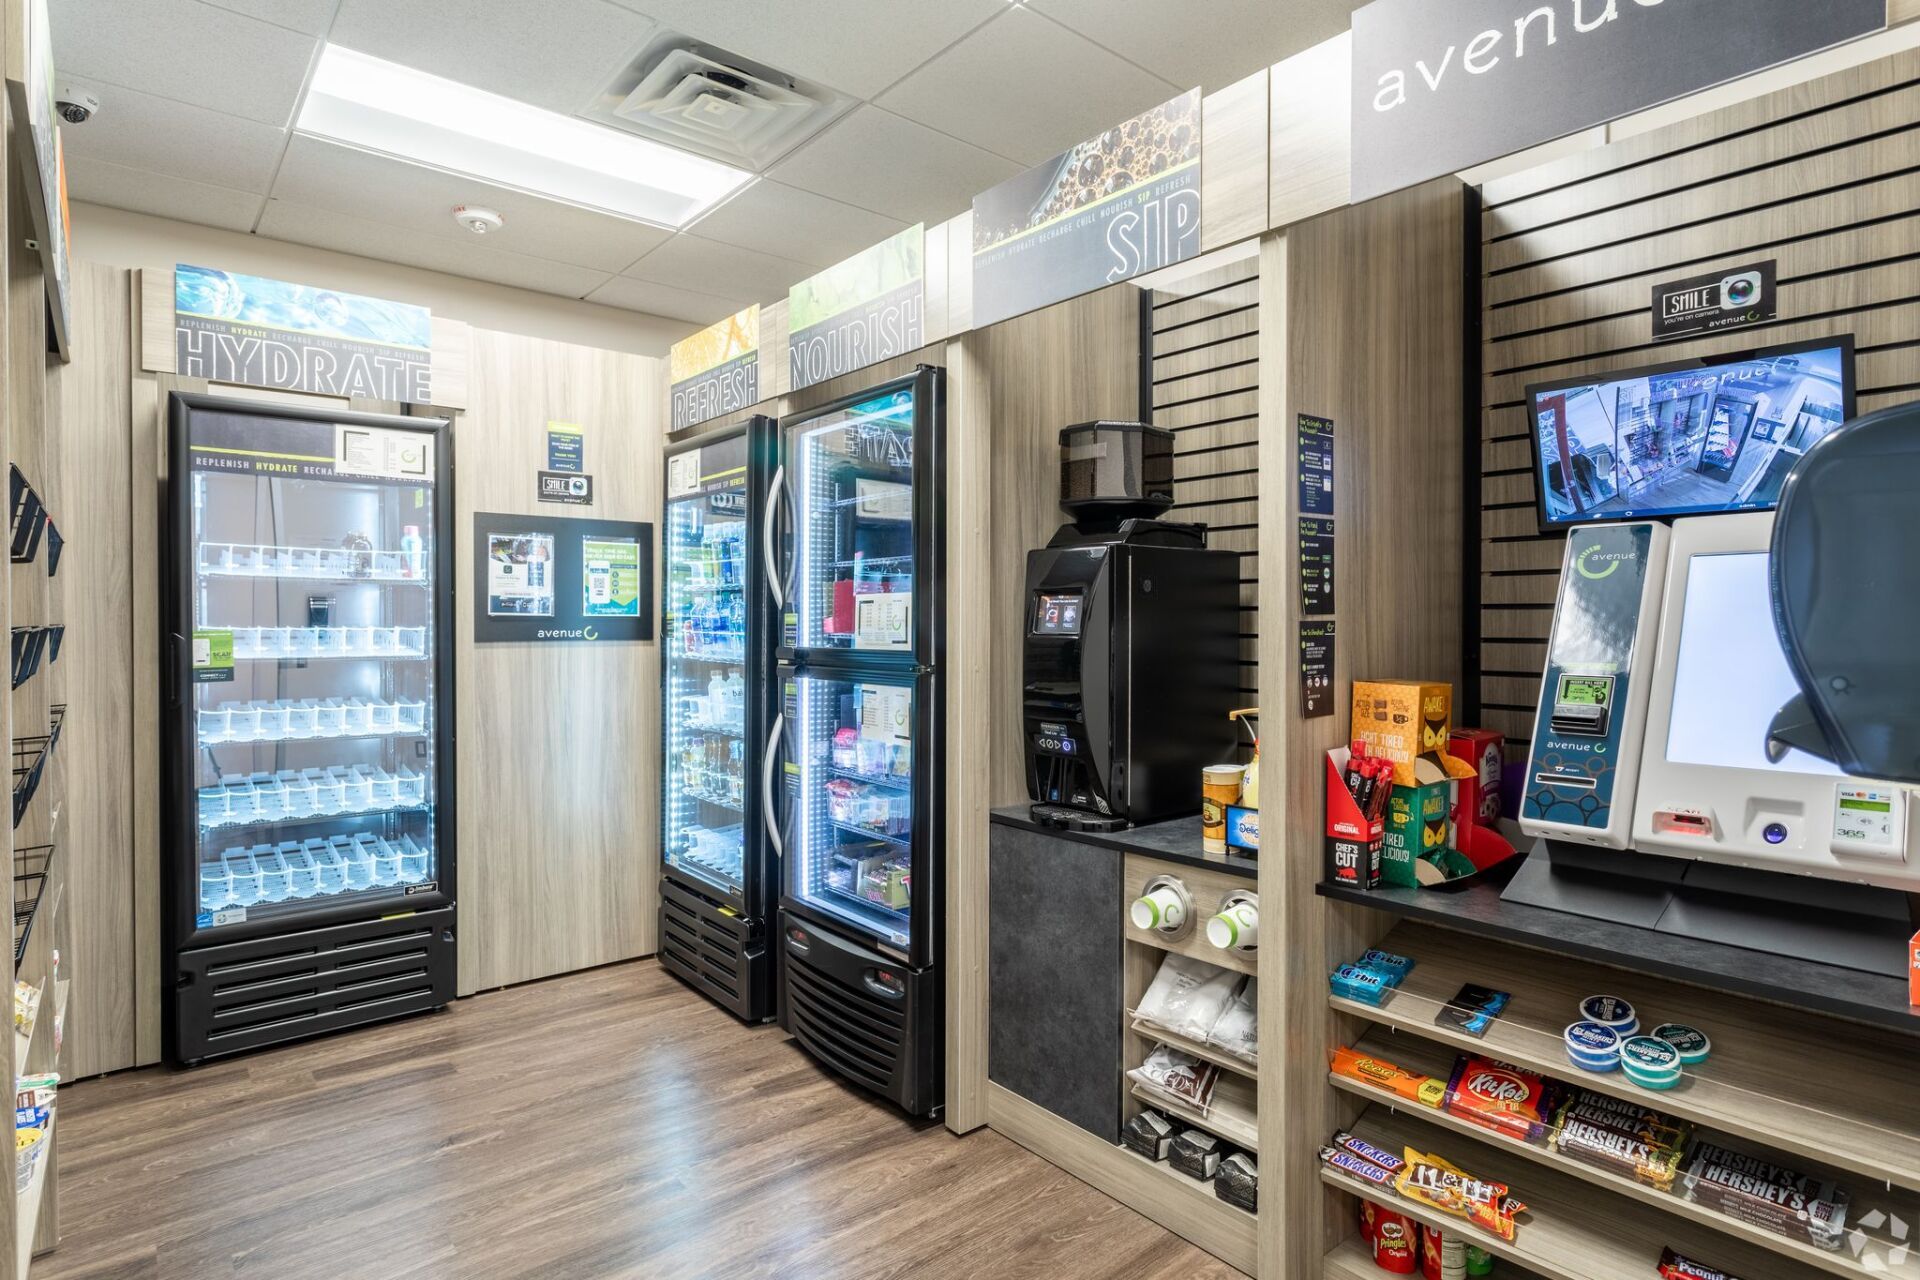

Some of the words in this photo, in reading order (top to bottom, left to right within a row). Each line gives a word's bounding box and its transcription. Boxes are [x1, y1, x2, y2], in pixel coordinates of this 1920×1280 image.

[1373, 0, 1664, 111] avenu
[1039, 224, 1072, 243] RECHARGE
[1077, 214, 1095, 229] CHILL
[1100, 199, 1133, 218] NOURISH
[1138, 191, 1151, 204] SIP
[1155, 175, 1191, 197] REFRESH
[1106, 189, 1200, 283] SIP
[1671, 289, 1710, 313] SMILE
[1664, 315, 1684, 326] you're
[1695, 309, 1719, 319] camera
[1709, 316, 1746, 327] avenue
[180, 320, 226, 333] REPLENISH
[231, 327, 267, 339] HYDRATE
[272, 332, 312, 345] RECHARGE
[789, 294, 924, 393] NOURISH
[176, 328, 431, 403] HYDRATE
[674, 361, 759, 431] REFRESH
[196, 457, 250, 470] REPLENISH
[256, 462, 298, 473] HYDRATE
[547, 479, 566, 490] SMILE
[1592, 552, 1636, 561] avenue
[537, 629, 582, 639] avenue
[1382, 734, 1404, 750] TIRED
[1547, 741, 1591, 751] avenue
[1334, 823, 1360, 835] ORIGINAL
[1837, 827, 1866, 840] 365
[1336, 842, 1358, 854] CHEF'S
[1336, 852, 1358, 868] CUT
[1365, 950, 1407, 967] Orbit
[1340, 967, 1380, 985] Orbit
[1566, 1119, 1650, 1160] HERSHEY'S
[1348, 1138, 1400, 1168] SNICKERS
[1334, 1153, 1387, 1181] SNICKERS
[1700, 1144, 1796, 1187] HERSHEY'S
[1705, 1165, 1806, 1210] HERSHEY'S
[1380, 1239, 1406, 1250] Pringles
[1679, 1262, 1726, 1280] Peanut
